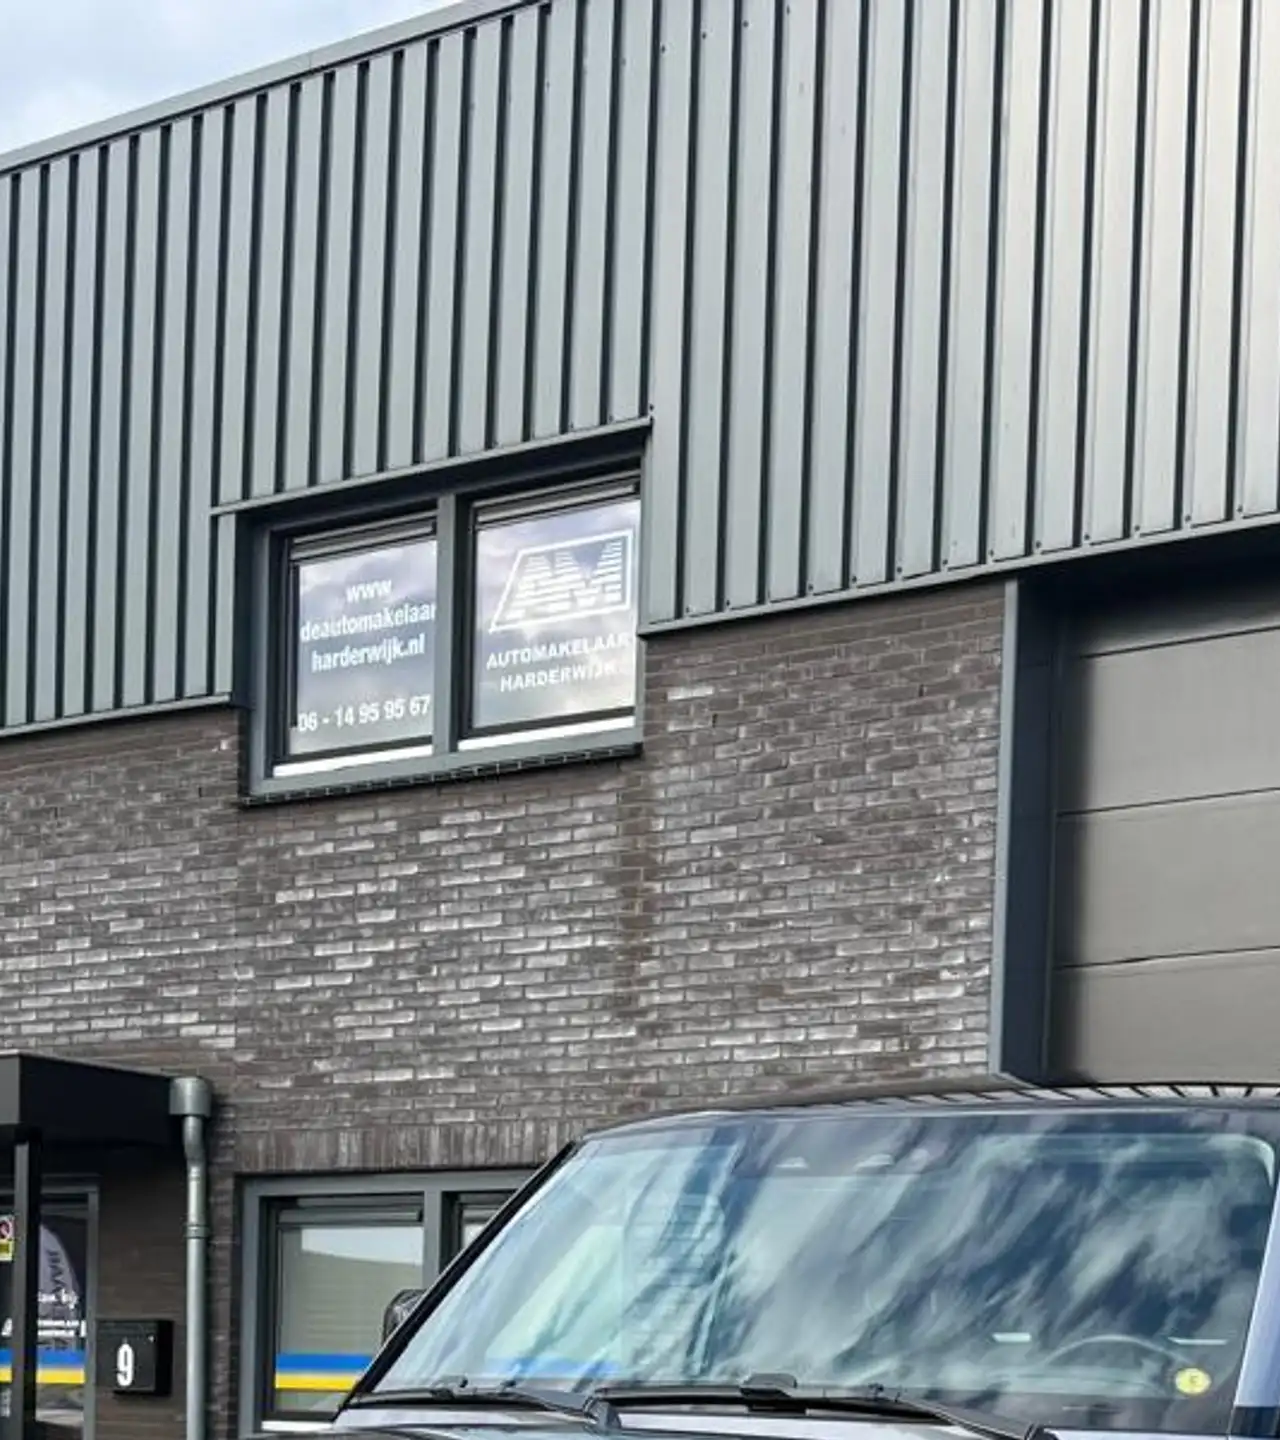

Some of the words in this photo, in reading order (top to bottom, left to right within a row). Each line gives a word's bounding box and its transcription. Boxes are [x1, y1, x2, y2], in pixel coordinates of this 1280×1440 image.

[311, 633, 426, 673] harderwijk.nl
[486, 632, 631, 670] AUTOMAKELAAR
[500, 660, 618, 692] HARDERWIJK
[335, 704, 355, 728] 14
[116, 1344, 135, 1388] 9
